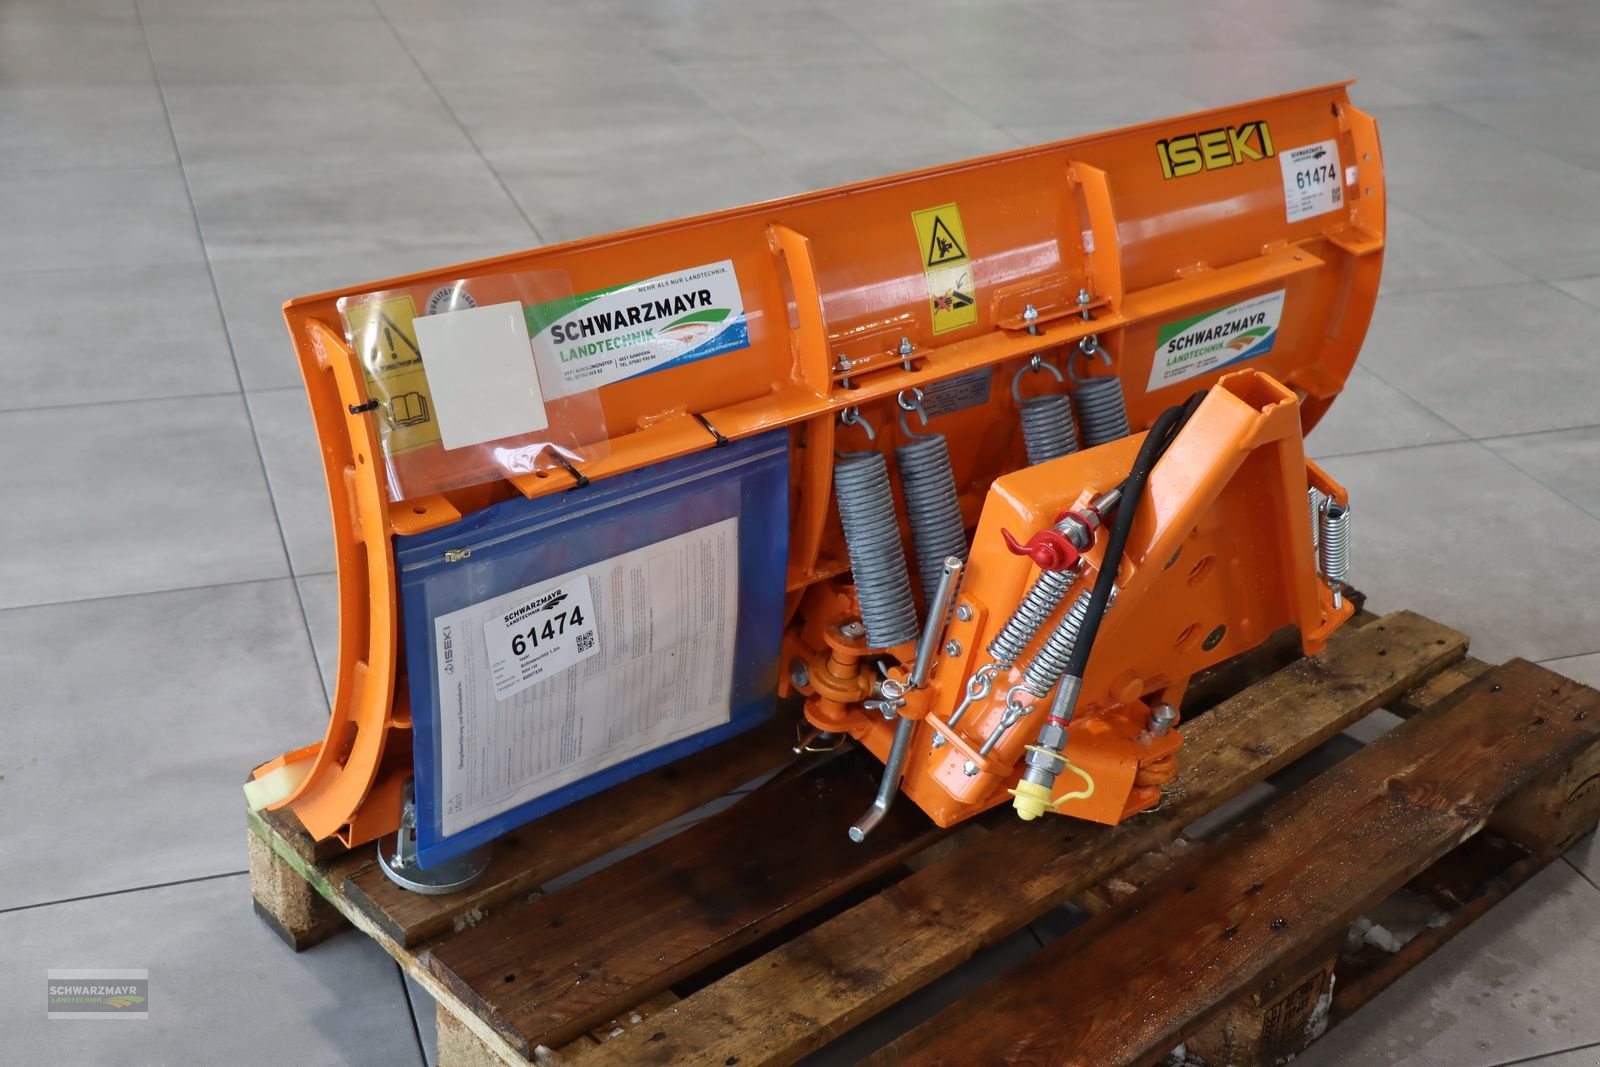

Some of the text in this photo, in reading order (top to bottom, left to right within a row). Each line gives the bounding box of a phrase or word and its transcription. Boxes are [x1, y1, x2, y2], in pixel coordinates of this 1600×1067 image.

[1156, 120, 1275, 180] ISEKI
[1296, 163, 1336, 190] 61474
[638, 285, 656, 293] MEHR
[670, 277, 684, 285] NUR
[551, 289, 713, 345] SCHWARZMAYR
[1167, 312, 1266, 353] SCHWARZMAYR
[560, 328, 656, 363] LANDTECHNIK
[1166, 341, 1225, 366] LANDTECHNIK
[504, 589, 562, 622] SCHWARZMAYR
[506, 608, 541, 627] LANDTECHNIK
[443, 625, 454, 664] ISEKI
[512, 605, 584, 656] 61474
